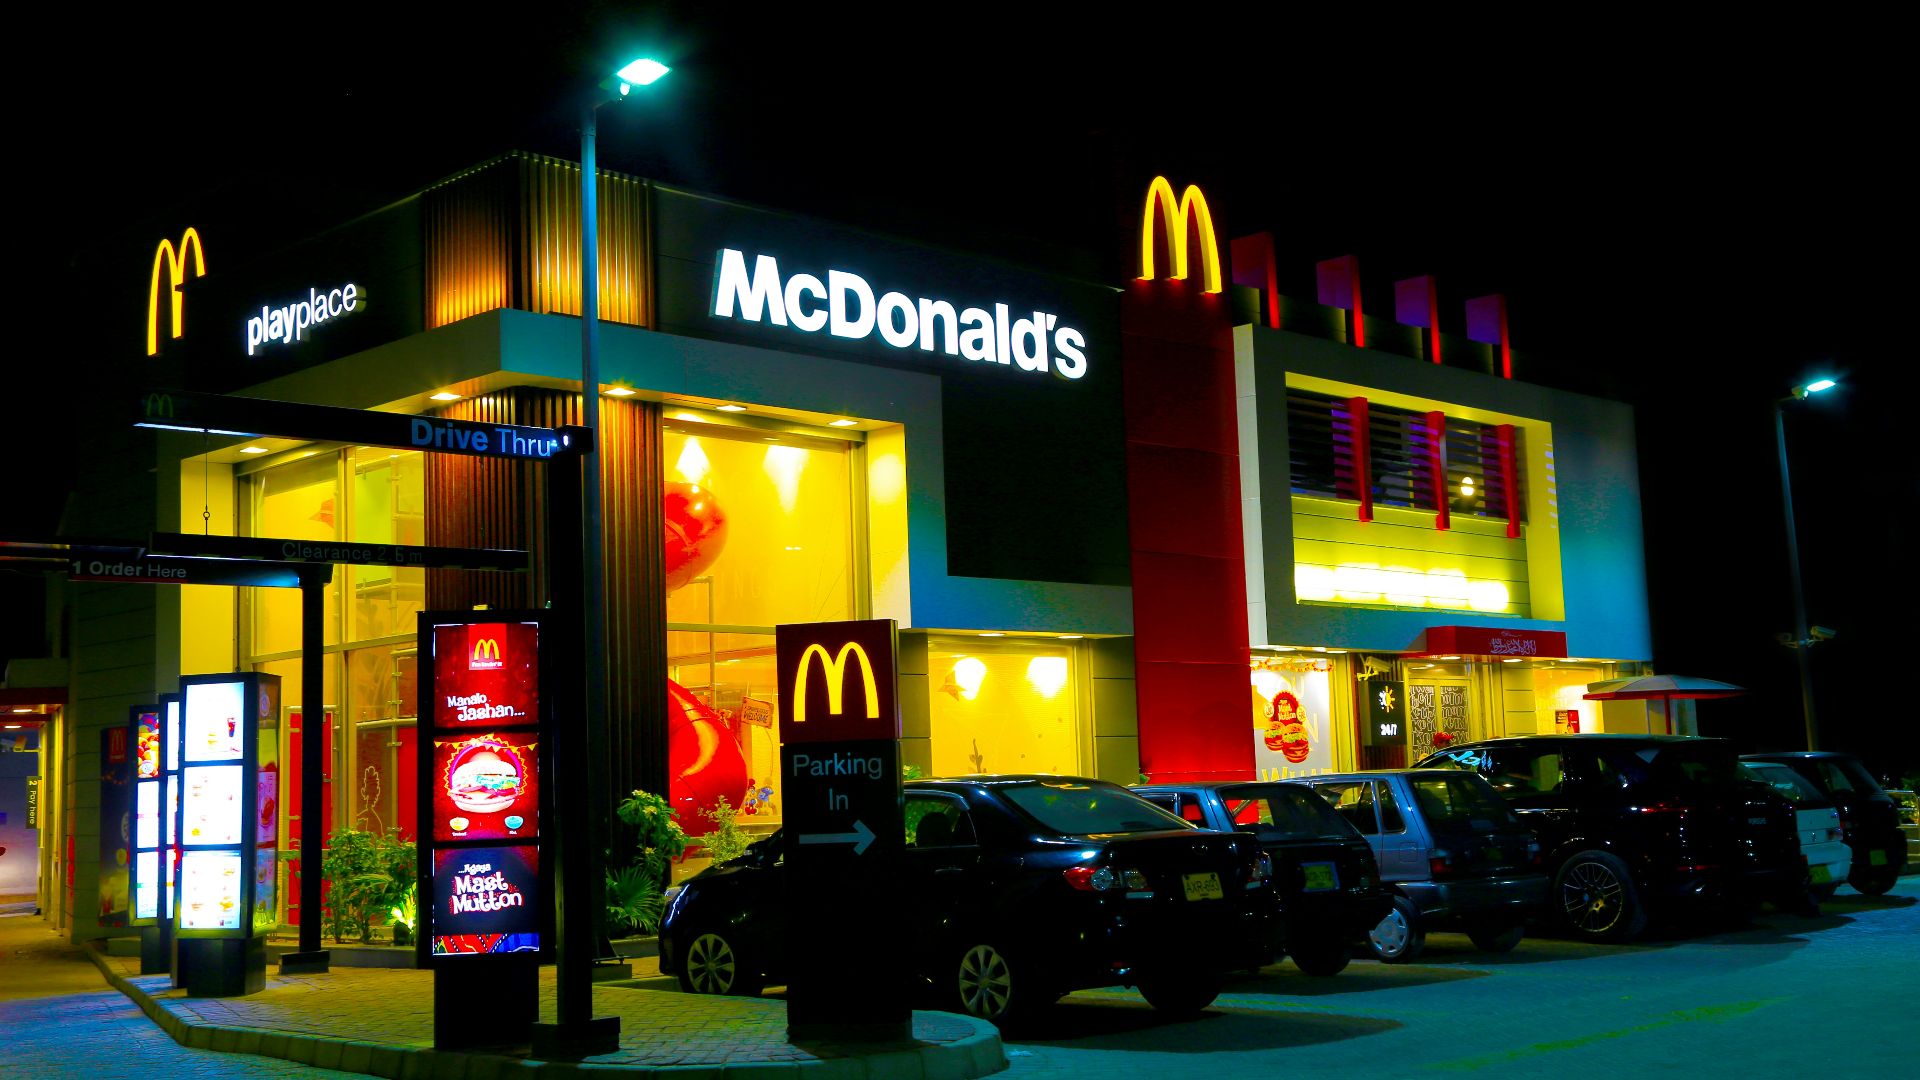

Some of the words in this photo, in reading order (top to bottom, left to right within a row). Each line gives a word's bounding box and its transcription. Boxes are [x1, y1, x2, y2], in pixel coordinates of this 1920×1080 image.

[246, 283, 359, 356] playplace
[712, 248, 1089, 380] McDonald's
[411, 417, 489, 452] Drive
[494, 427, 552, 457] Thru
[281, 541, 373, 561] Clearance
[72, 560, 82, 575] 1
[88, 560, 144, 577] Order
[147, 562, 188, 578] Here
[447, 692, 487, 708] Manalo
[1379, 723, 1398, 736] 24/7
[793, 753, 883, 780] Parking
[28, 790, 38, 805] Pay
[828, 788, 849, 811] In
[29, 807, 37, 825] here
[454, 871, 509, 895] Mast
[451, 890, 523, 915] Mutton
